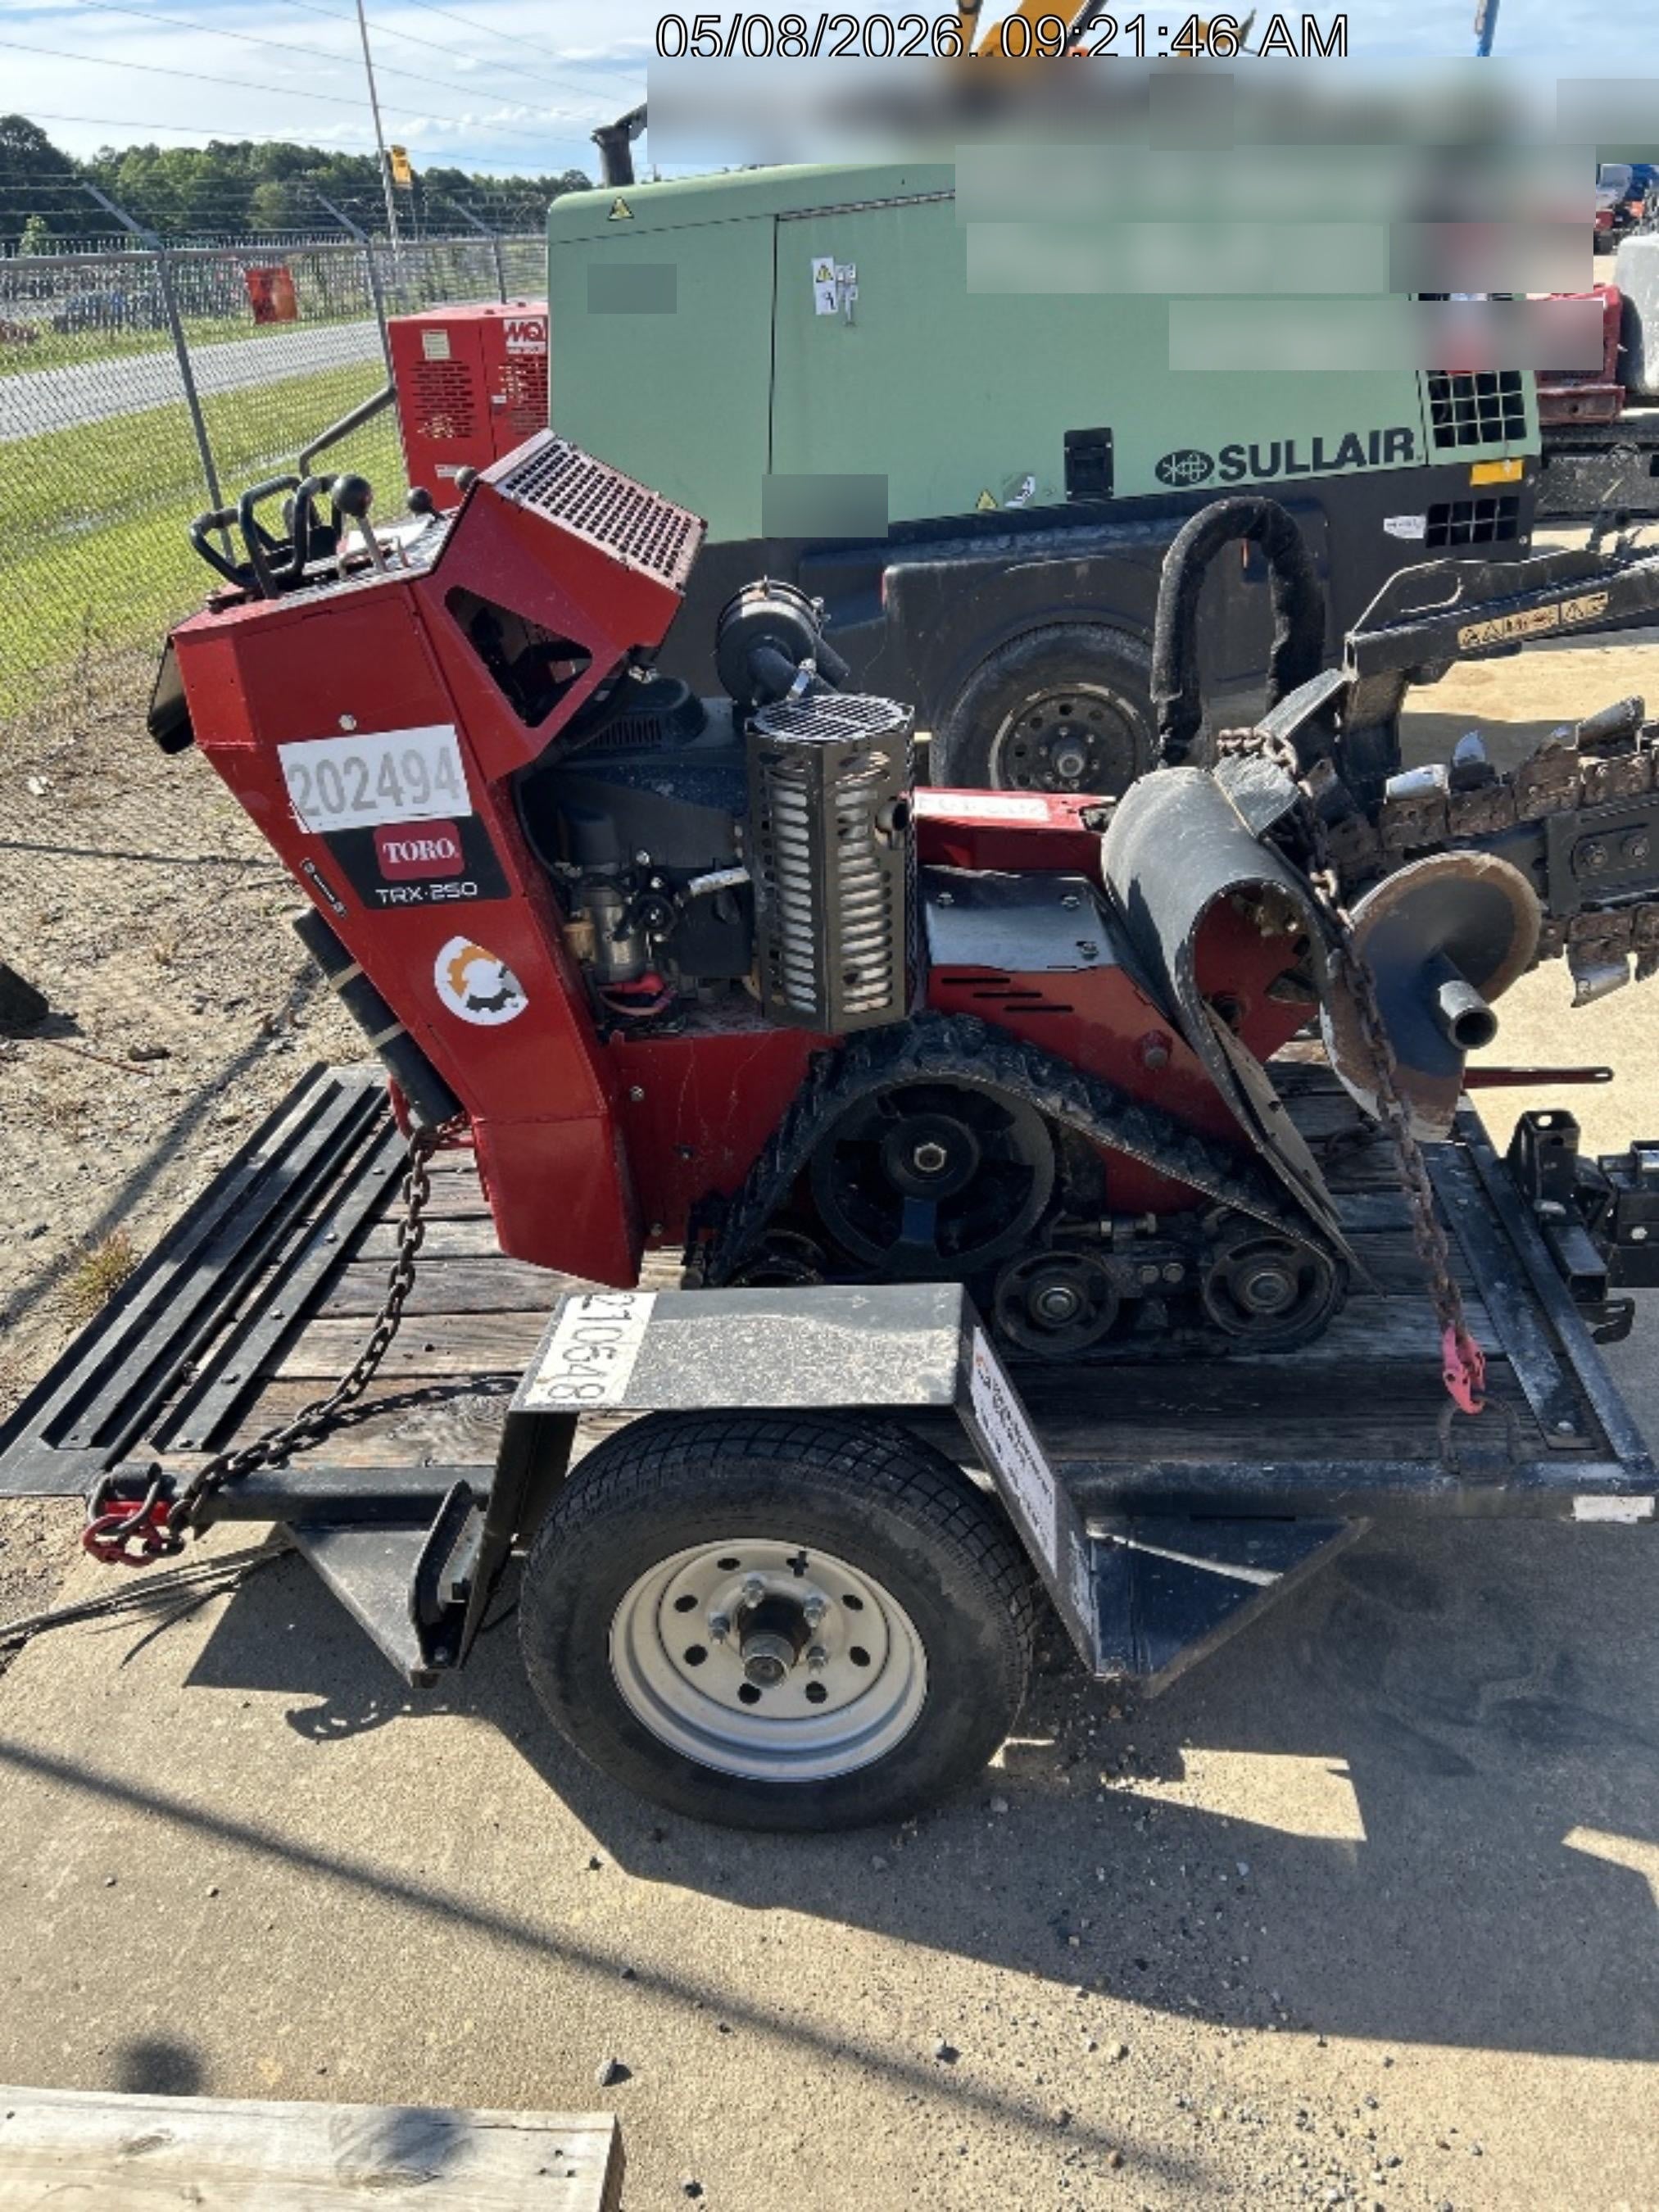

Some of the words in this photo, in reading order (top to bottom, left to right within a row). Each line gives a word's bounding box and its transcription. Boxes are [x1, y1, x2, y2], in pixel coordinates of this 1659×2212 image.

[505, 321, 544, 341] MQ
[1219, 427, 1414, 482] SULLAIR
[288, 746, 460, 817] 202494
[383, 838, 453, 863] TORO
